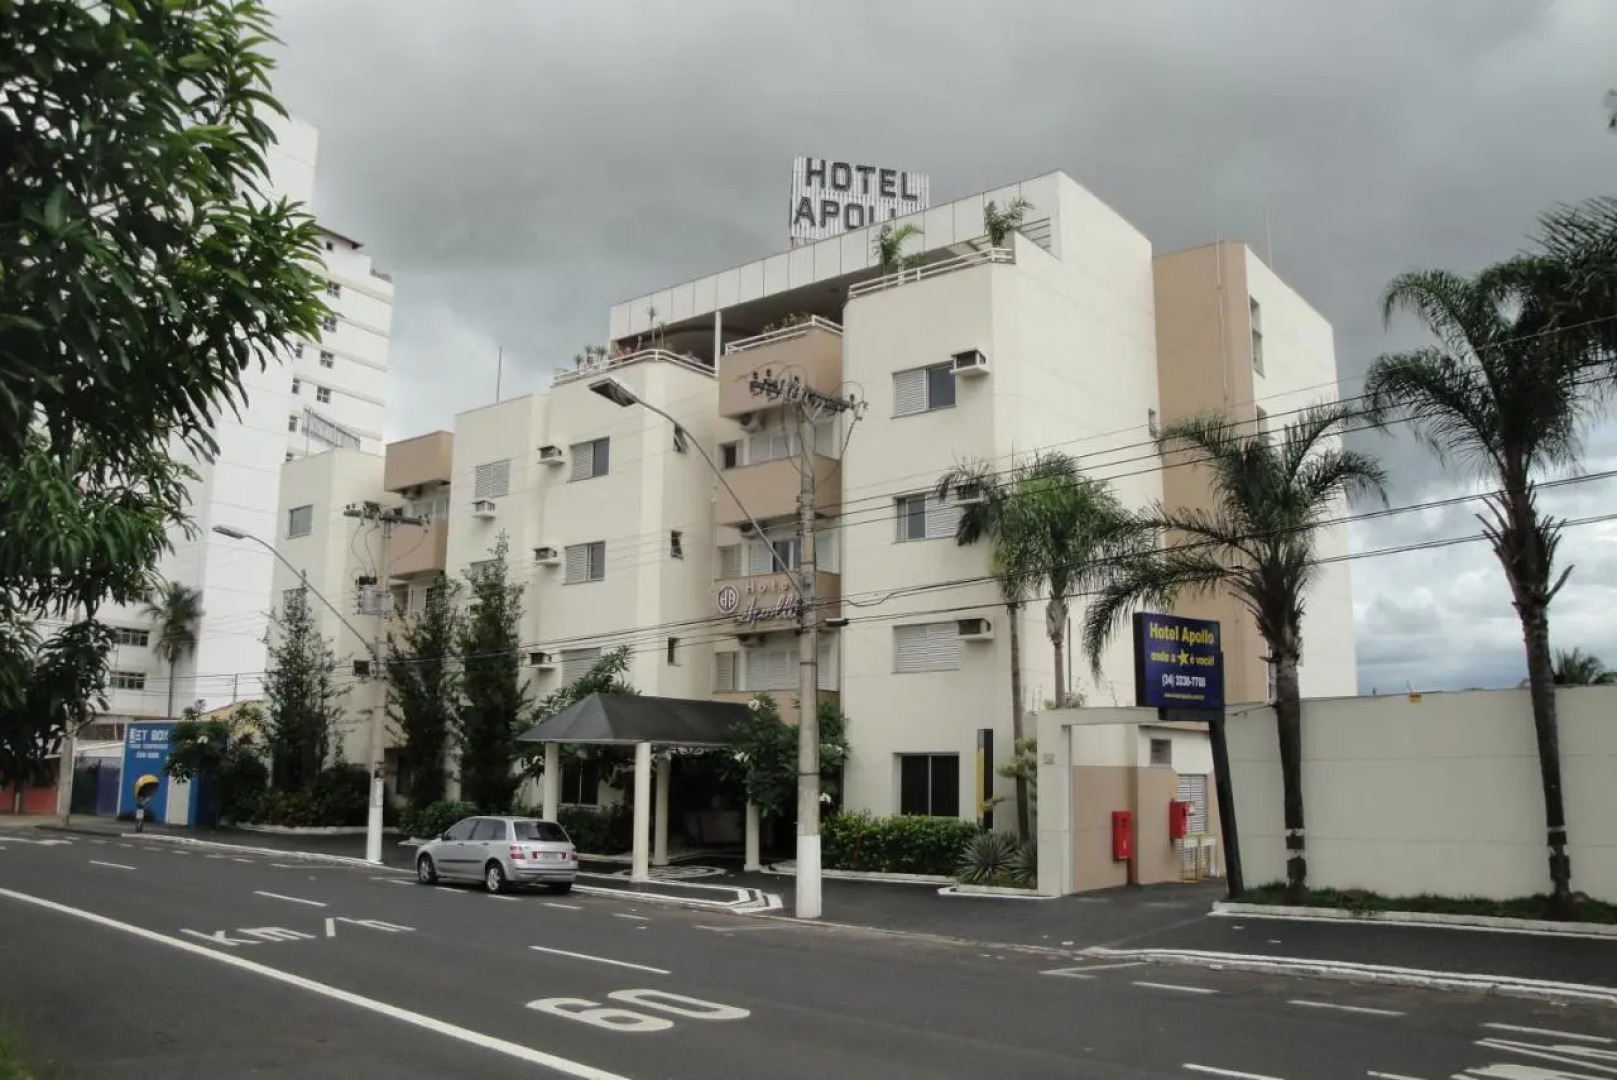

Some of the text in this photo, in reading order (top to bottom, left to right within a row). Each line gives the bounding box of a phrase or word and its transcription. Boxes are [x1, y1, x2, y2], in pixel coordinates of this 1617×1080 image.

[806, 157, 918, 201] HOTEL
[1149, 622, 1179, 641] Hotel
[525, 989, 751, 1032] 60
